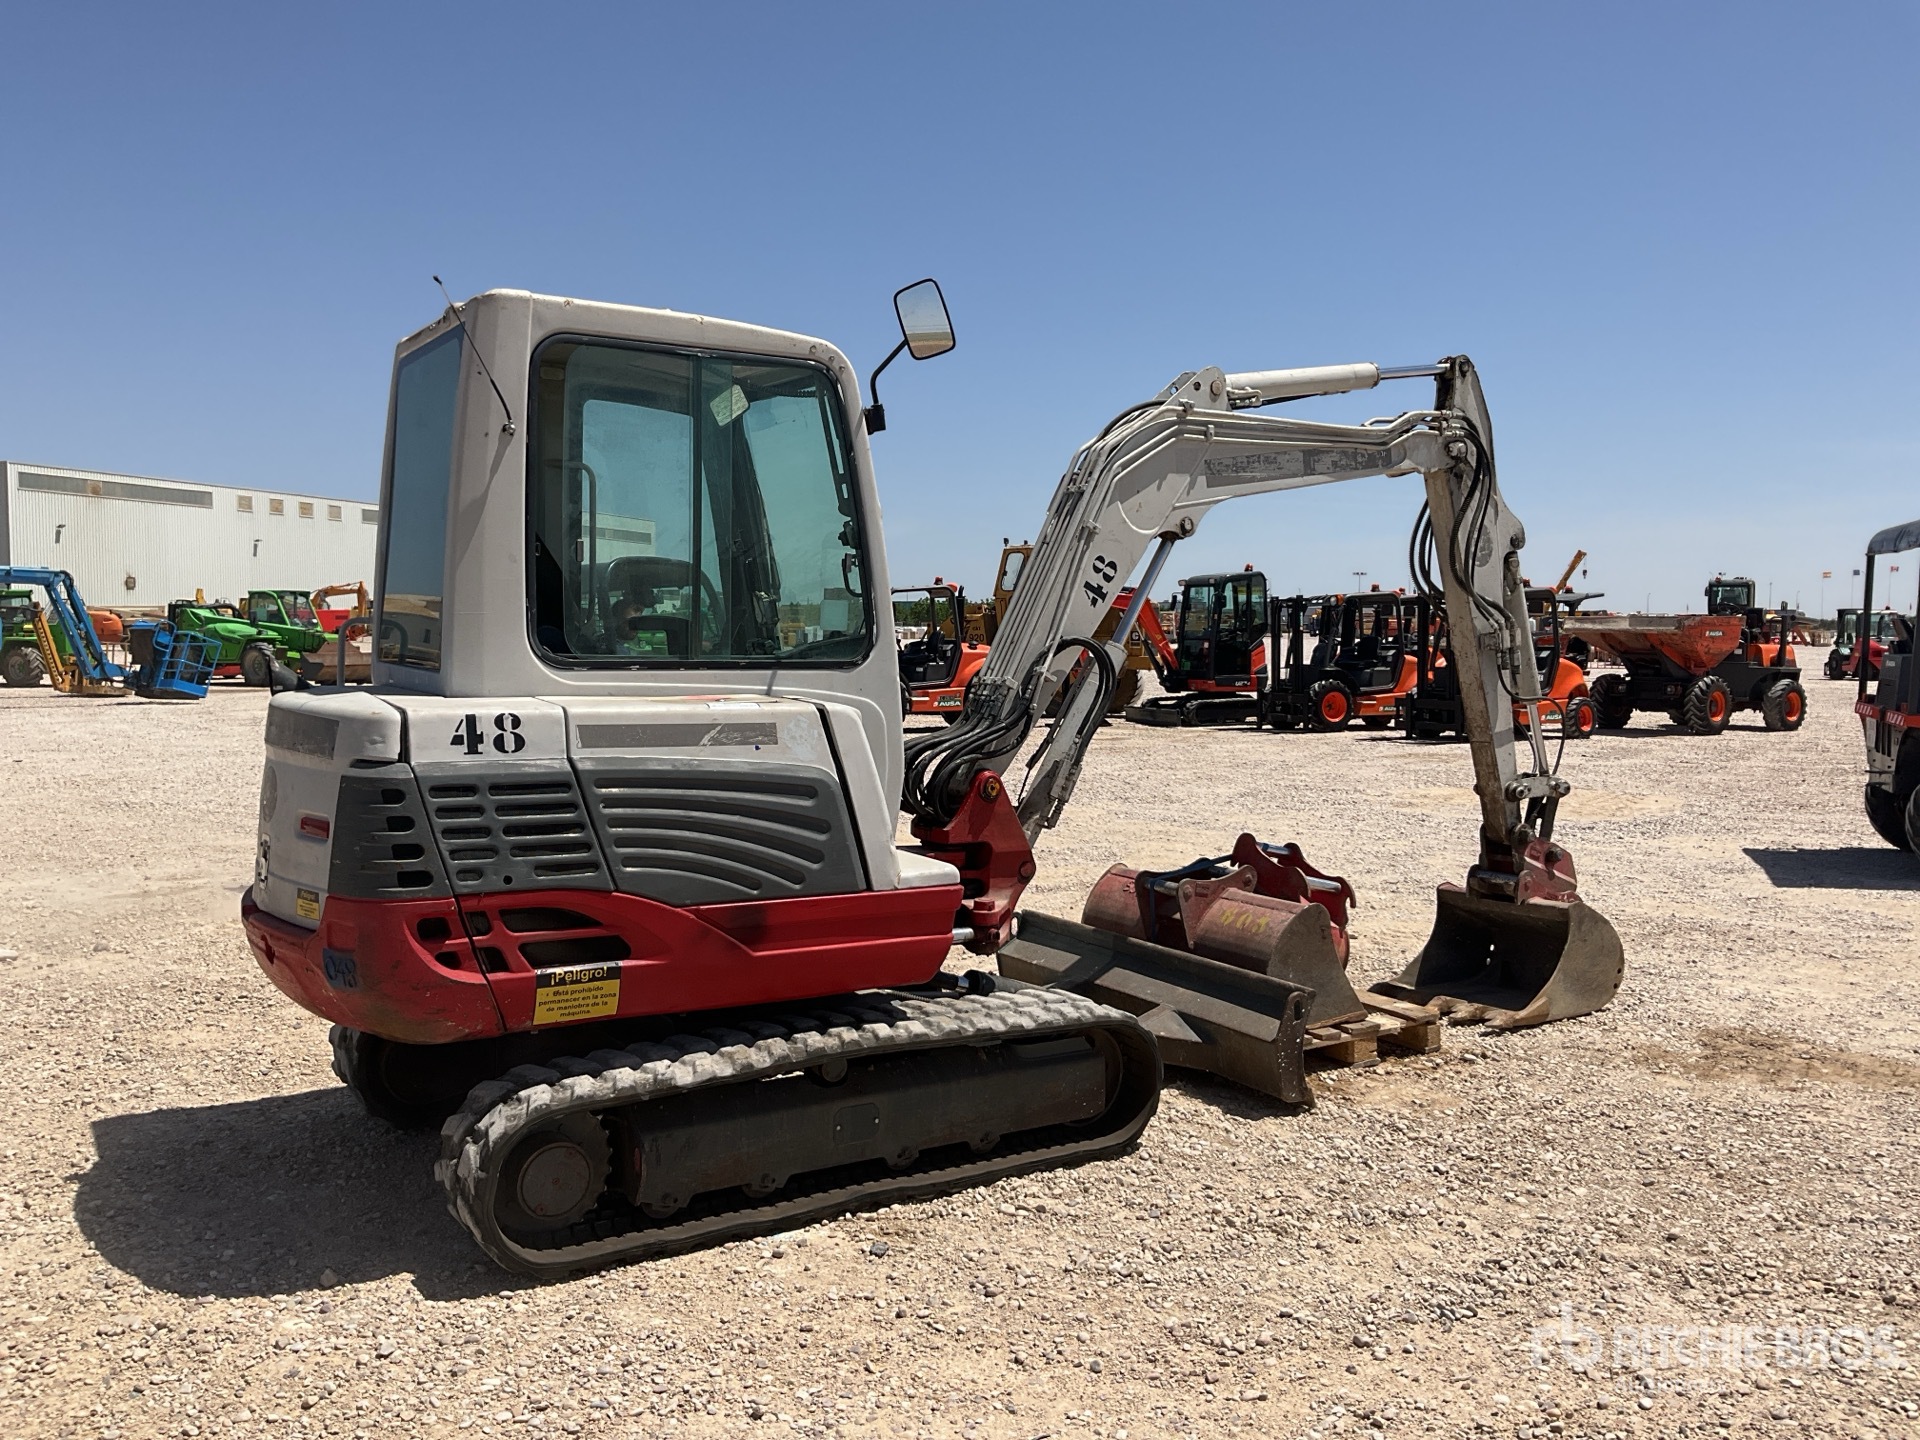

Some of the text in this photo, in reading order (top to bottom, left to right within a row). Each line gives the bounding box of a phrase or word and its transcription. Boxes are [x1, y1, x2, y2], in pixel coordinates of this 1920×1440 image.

[1083, 555, 1117, 608] 48
[970, 633, 985, 642] 920
[450, 713, 526, 755] 48
[551, 965, 607, 986] ¡Peligro!
[553, 985, 604, 997] Está prohibido
[538, 996, 581, 1007] permanecer
[592, 992, 599, 1000] la
[556, 1001, 590, 1011] maniobra
[591, 999, 600, 1007] de
